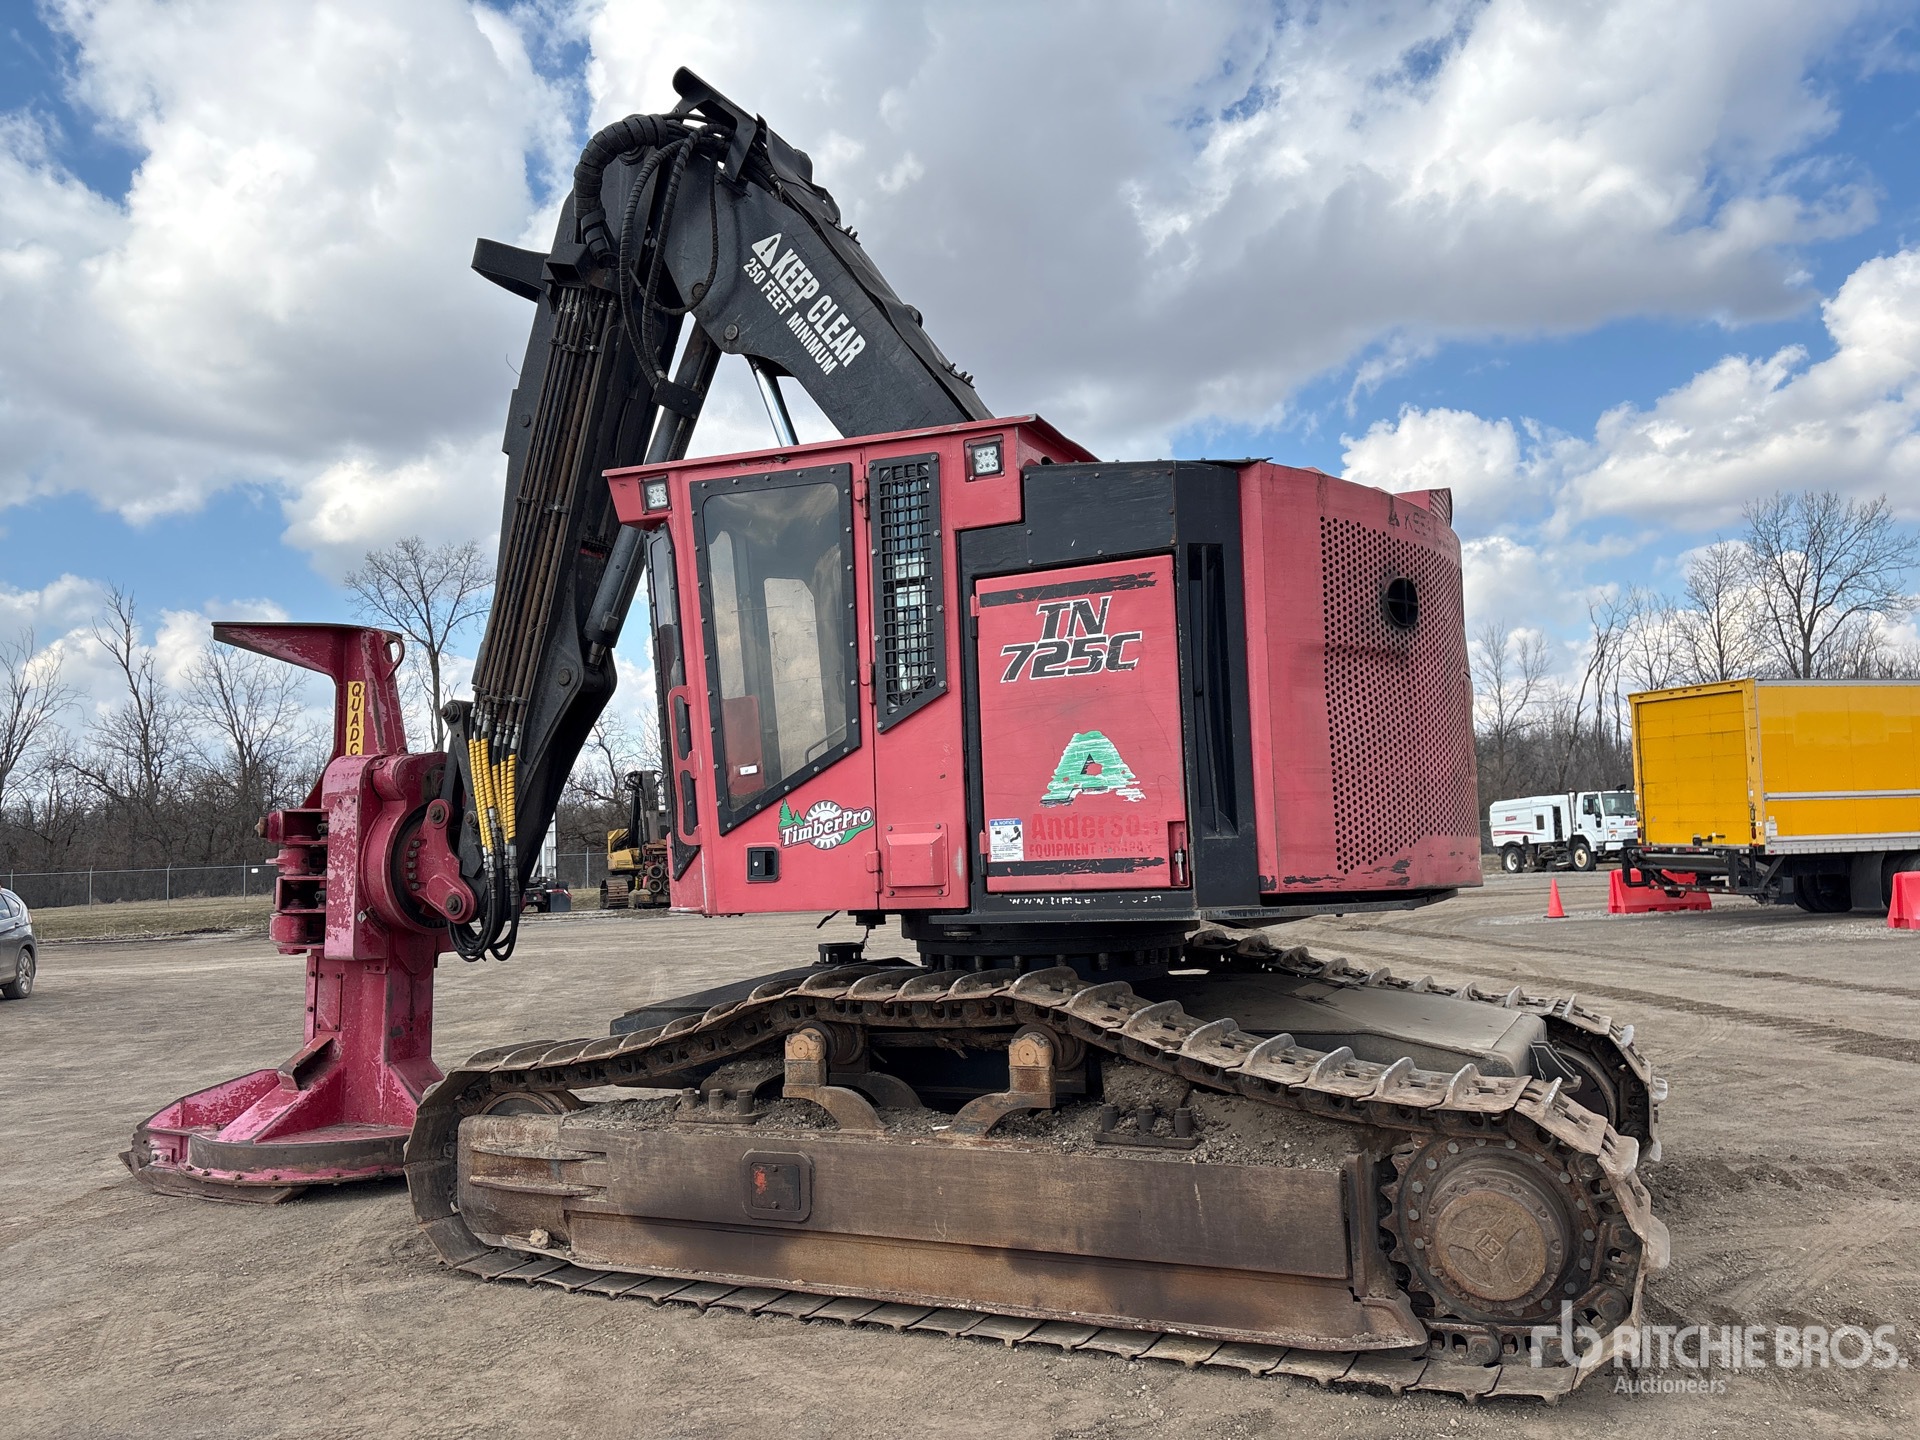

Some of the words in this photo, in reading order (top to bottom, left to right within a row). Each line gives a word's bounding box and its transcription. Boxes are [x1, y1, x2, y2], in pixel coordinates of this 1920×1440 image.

[743, 257, 766, 284] 250
[760, 279, 792, 315] FEET
[786, 311, 838, 375] MINIMUM
[770, 248, 820, 304] KEEP
[807, 295, 866, 368] CLEAR
[1036, 595, 1113, 641] TN
[1000, 630, 1143, 683] 725C
[782, 810, 872, 846] TimberPro
[1031, 811, 1160, 842] Anderso
